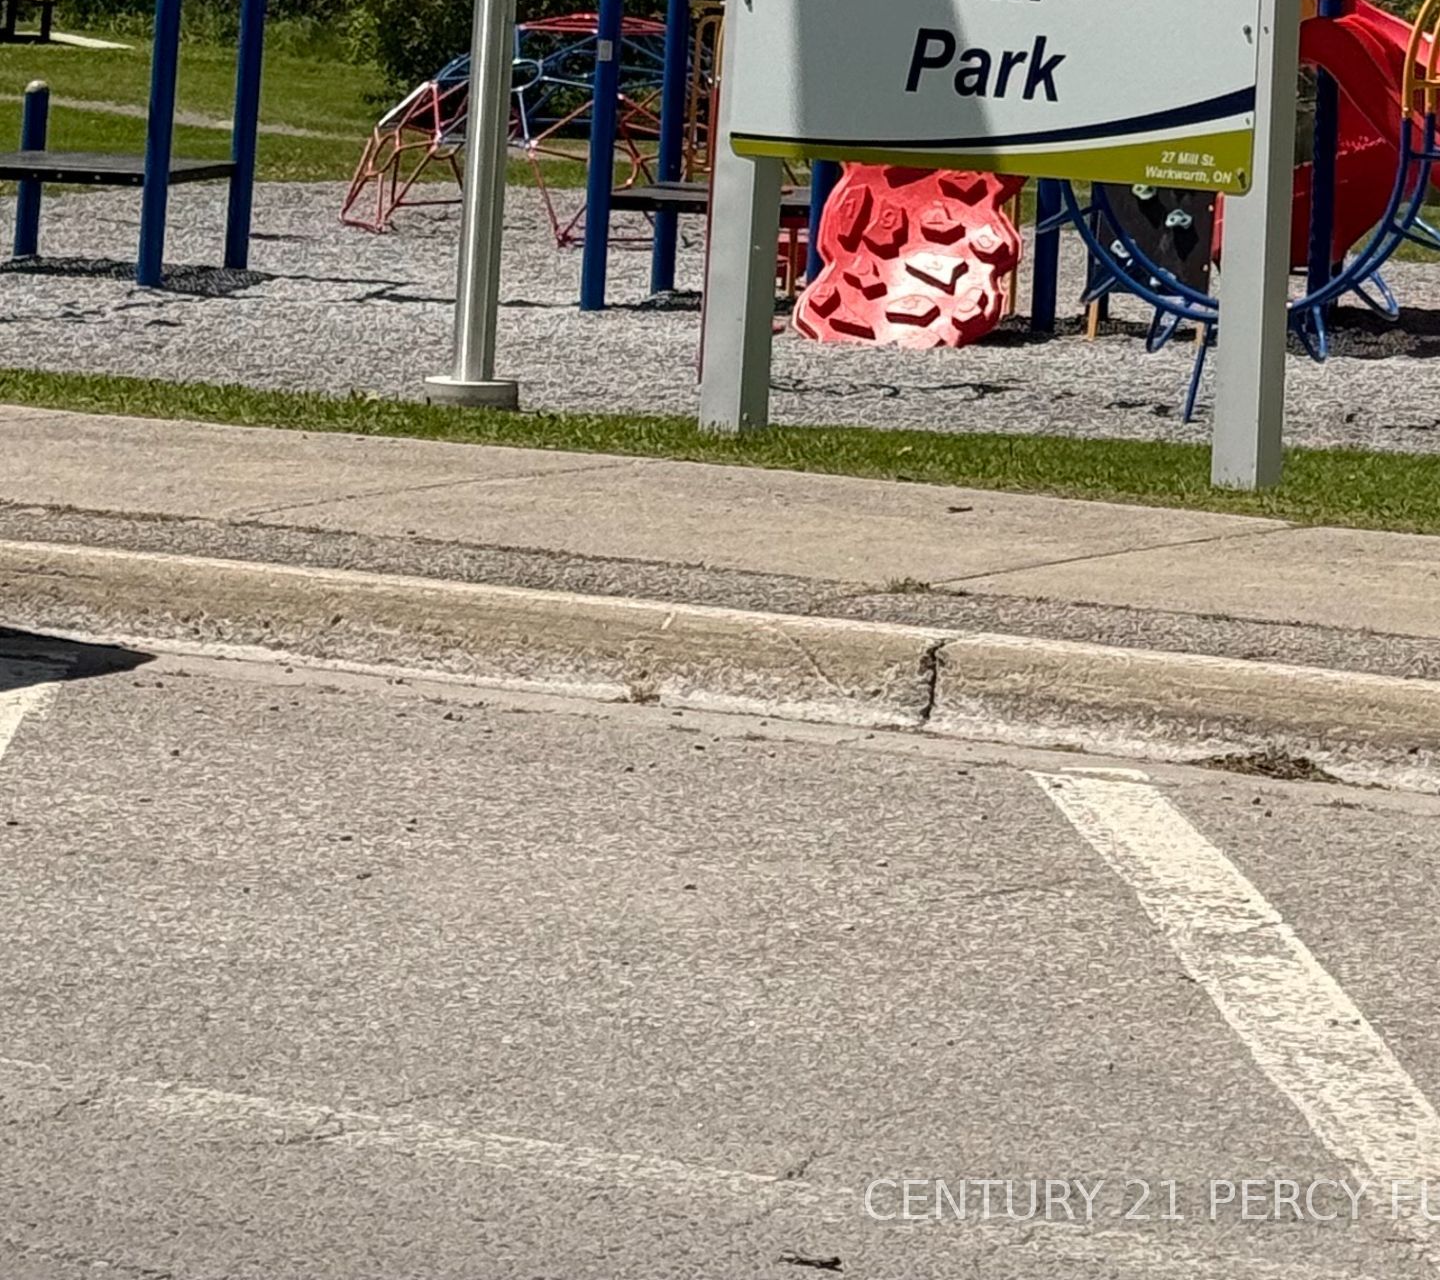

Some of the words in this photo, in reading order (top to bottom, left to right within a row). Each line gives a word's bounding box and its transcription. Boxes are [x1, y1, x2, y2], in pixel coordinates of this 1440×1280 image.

[904, 27, 1067, 103] Park
[1161, 151, 1175, 163] 27
[1178, 152, 1198, 165] Mill
[1145, 165, 1210, 183] Warkworth,
[1213, 171, 1232, 184] ON
